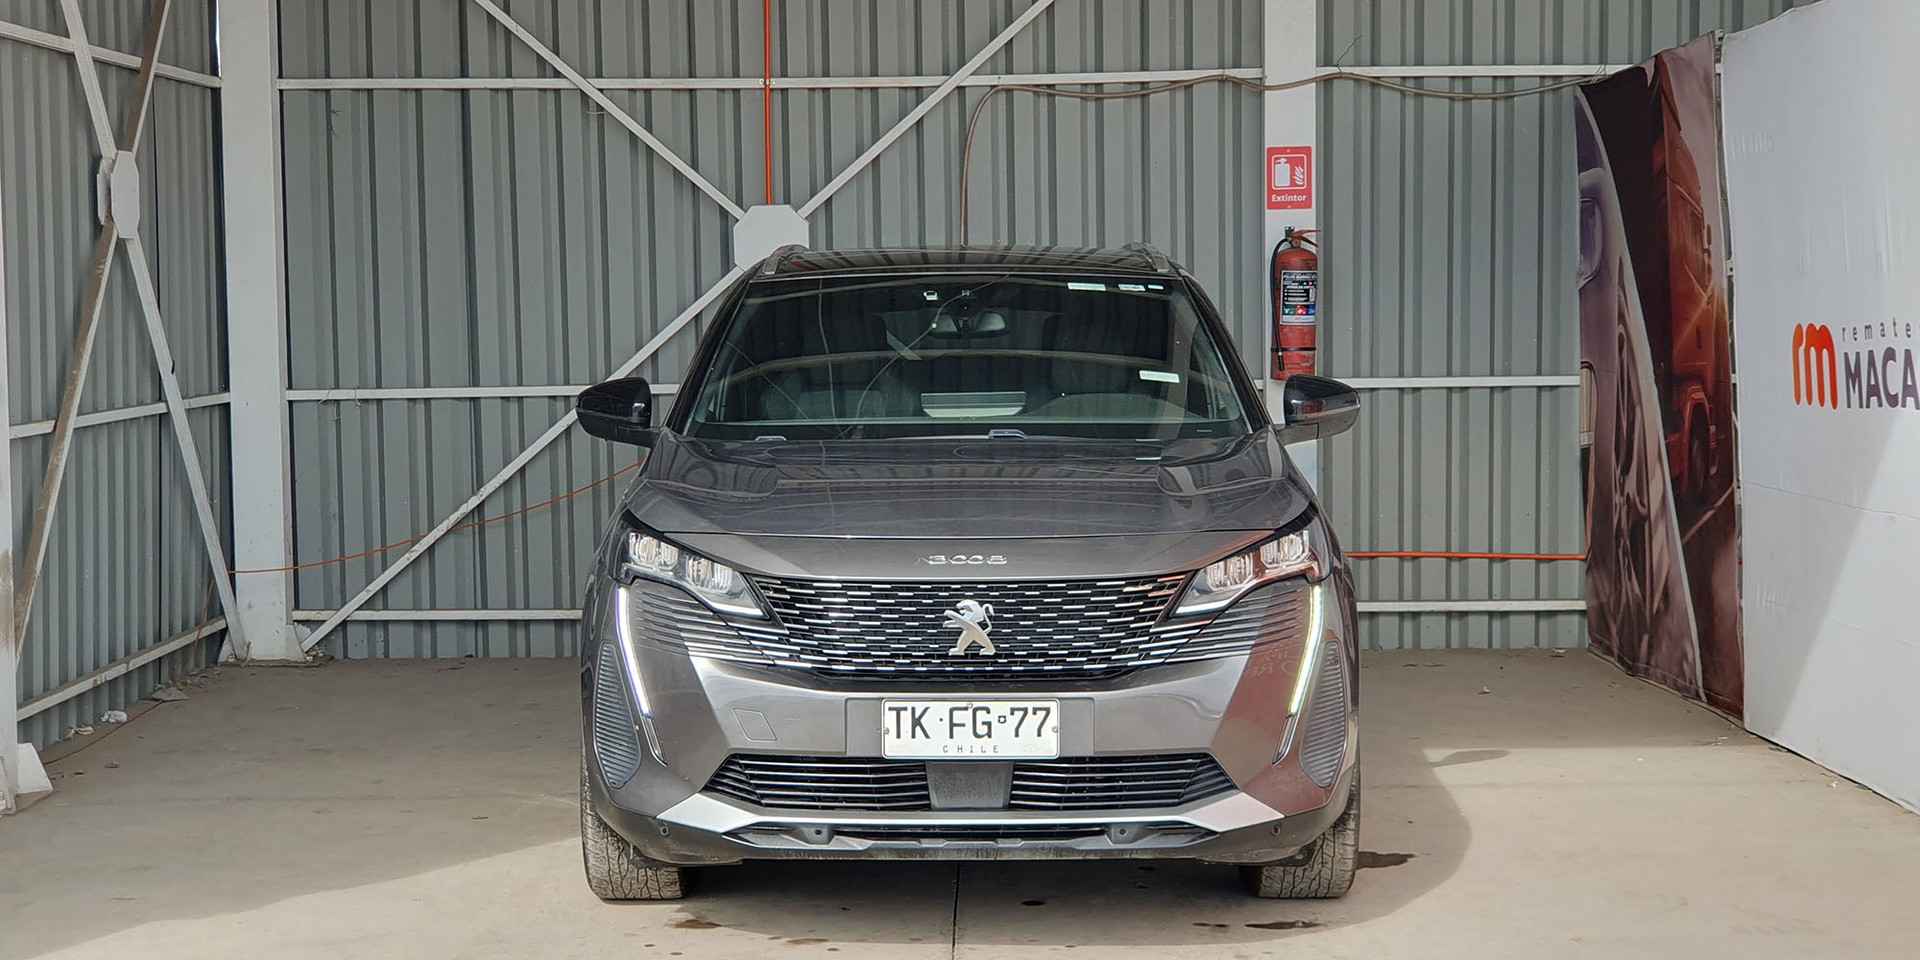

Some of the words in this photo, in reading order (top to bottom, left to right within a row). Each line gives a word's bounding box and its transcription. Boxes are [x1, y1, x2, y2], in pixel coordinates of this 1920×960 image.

[1271, 194, 1307, 203] Extintor
[1842, 317, 1920, 342] remate
[1843, 346, 1920, 411] MACA
[928, 554, 1008, 565] 3008
[942, 745, 999, 754] CHILE
